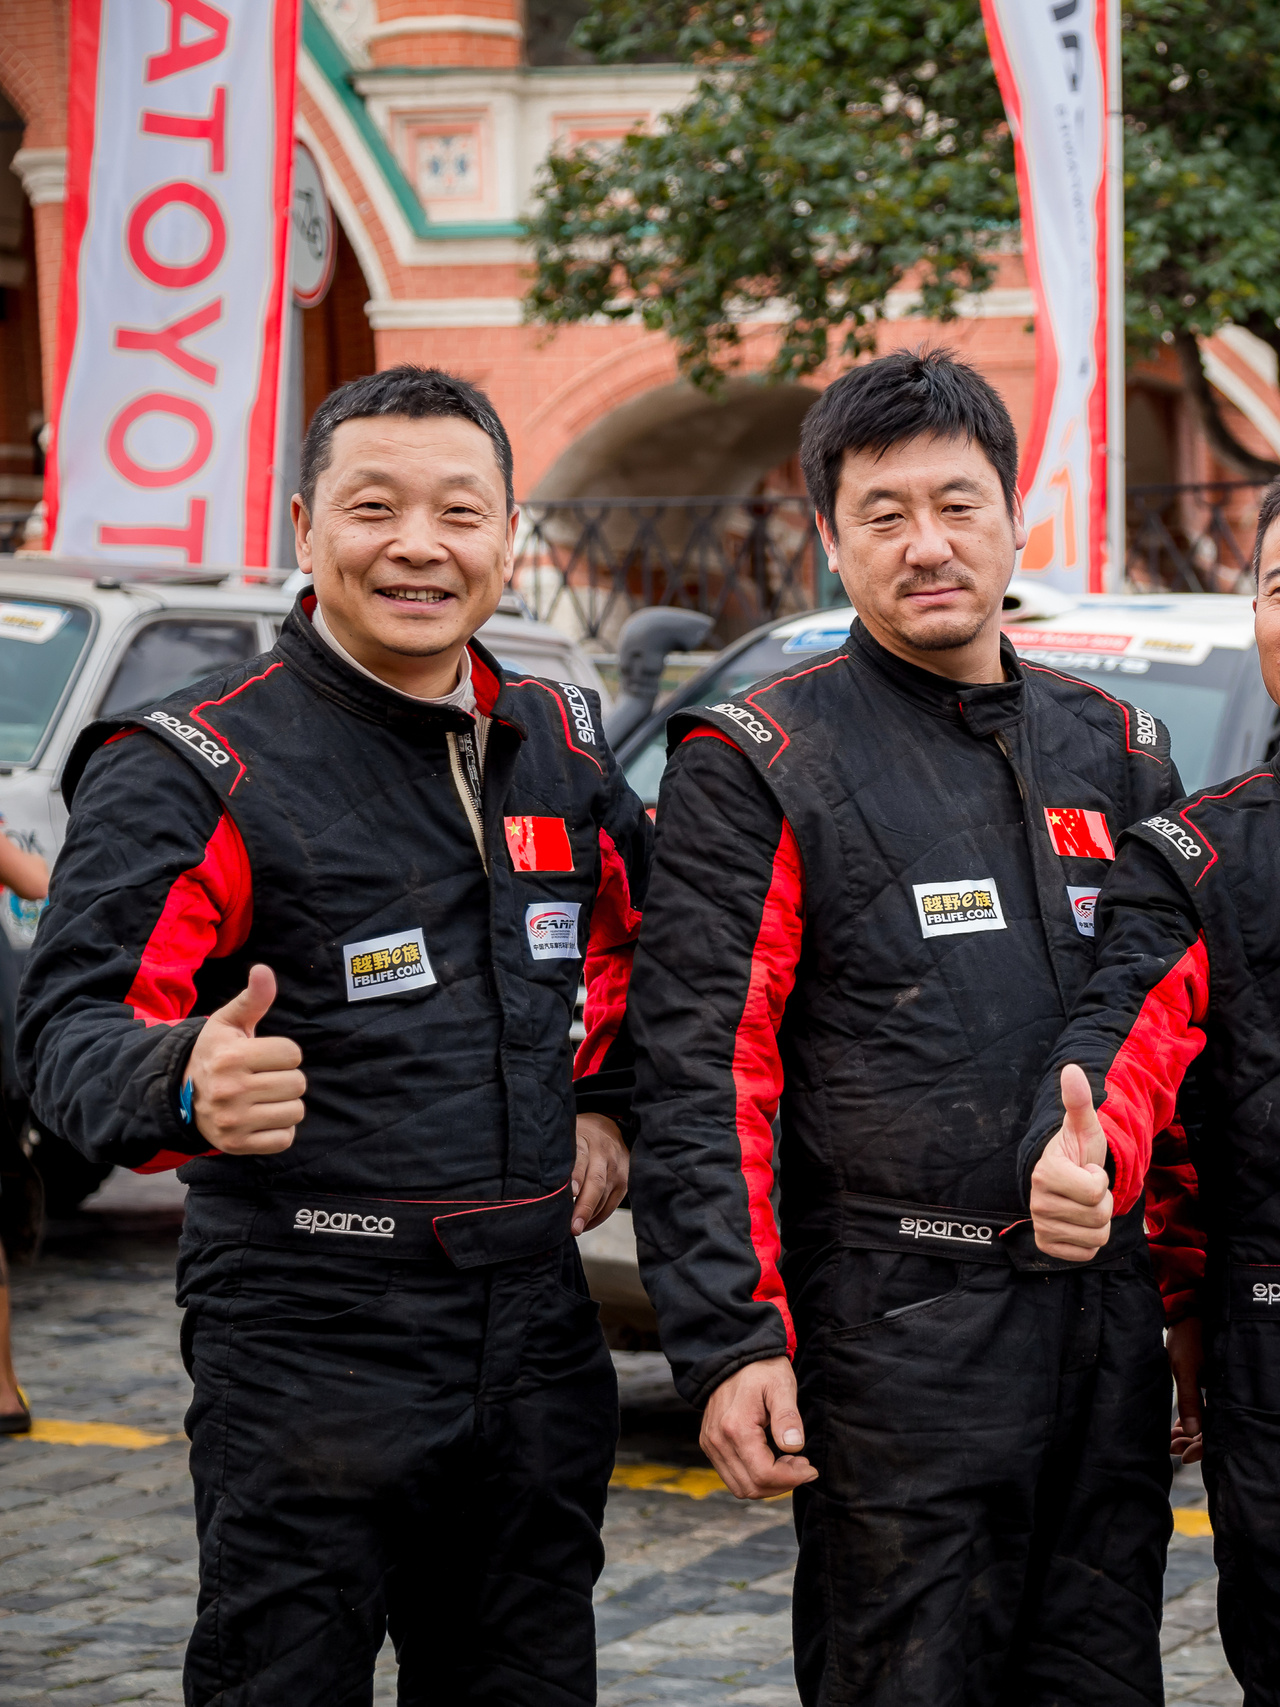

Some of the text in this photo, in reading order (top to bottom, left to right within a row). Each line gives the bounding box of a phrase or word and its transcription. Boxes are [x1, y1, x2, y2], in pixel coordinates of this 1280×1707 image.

[144, 711, 230, 768] sparco
[1134, 706, 1158, 746] sparc
[1141, 816, 1202, 860] sparco
[922, 890, 994, 913] 越野e族
[926, 908, 996, 925] FBLIFE.COM
[351, 943, 421, 975] 越野e族
[354, 962, 424, 987] FBLIFE.COM
[294, 1208, 395, 1238] sparco
[899, 1217, 993, 1245] sparco
